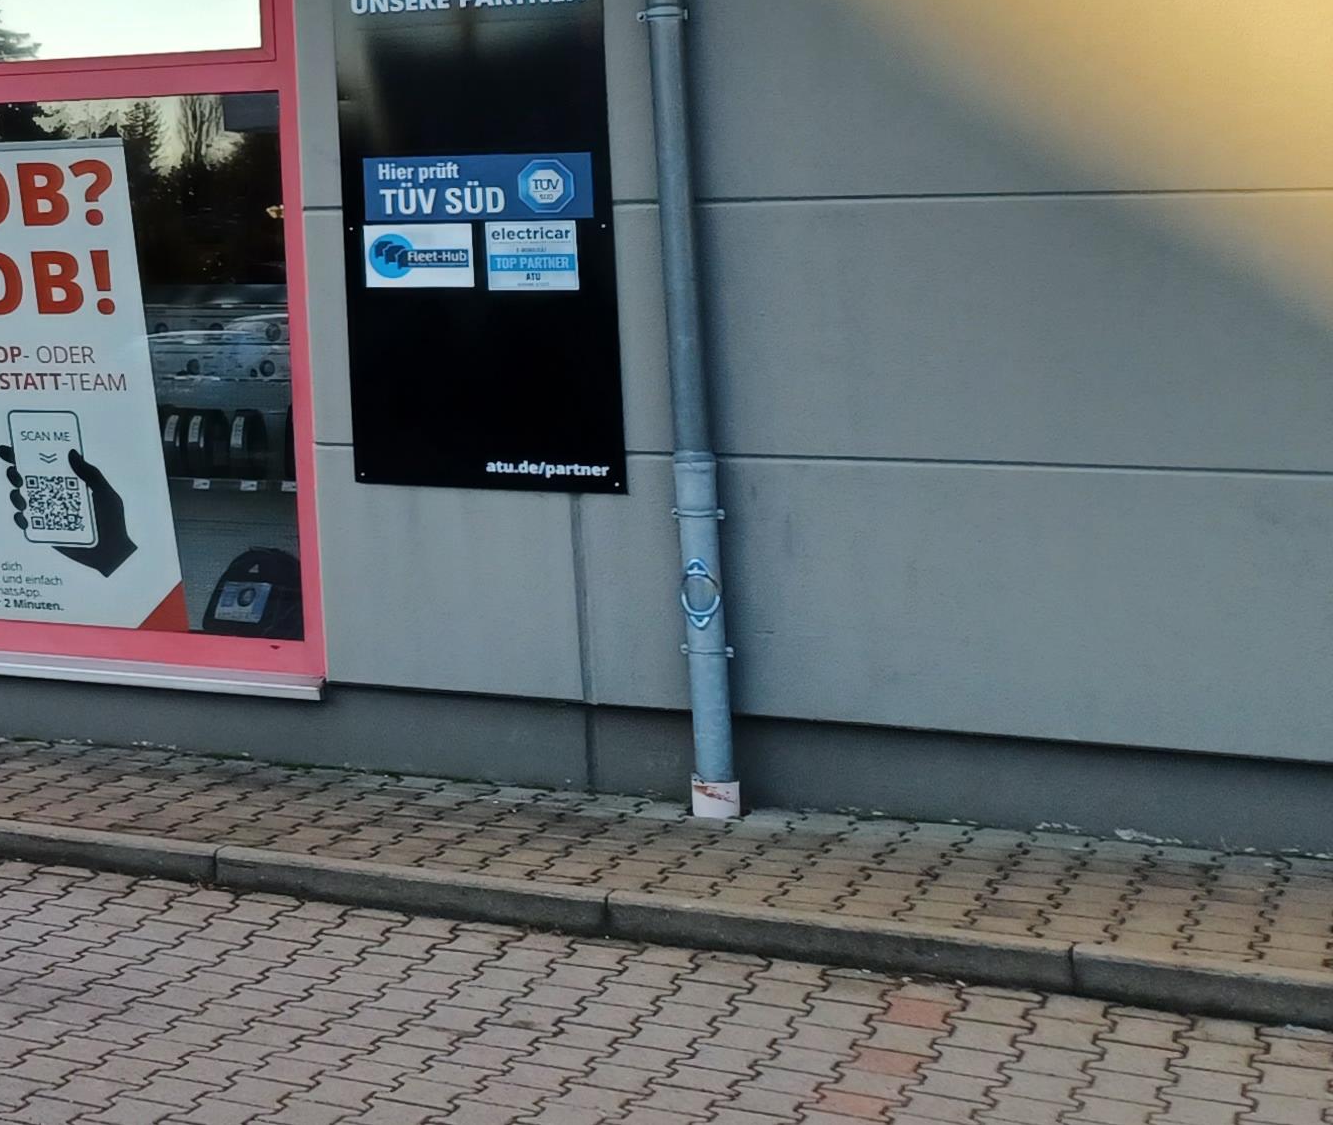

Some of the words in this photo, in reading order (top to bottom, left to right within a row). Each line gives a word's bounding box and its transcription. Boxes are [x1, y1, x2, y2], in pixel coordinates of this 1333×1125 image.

[378, 163, 415, 181] Hier
[418, 162, 459, 183] prüft
[379, 182, 436, 215] TÜV
[445, 181, 505, 214] SÜD
[491, 226, 571, 240] electricar
[407, 250, 467, 262] Fleet-Hub
[495, 257, 517, 269] TOP
[519, 256, 570, 269] PARTNER
[36, 345, 95, 364] ODER
[20, 431, 51, 441] SCAN
[53, 432, 70, 442] ME
[486, 460, 610, 478] atu.de/partner
[1, 561, 23, 571] dich
[2, 574, 22, 584] und
[25, 575, 63, 586] einfach
[4, 598, 11, 608] 2
[13, 599, 65, 611] Minuten.
